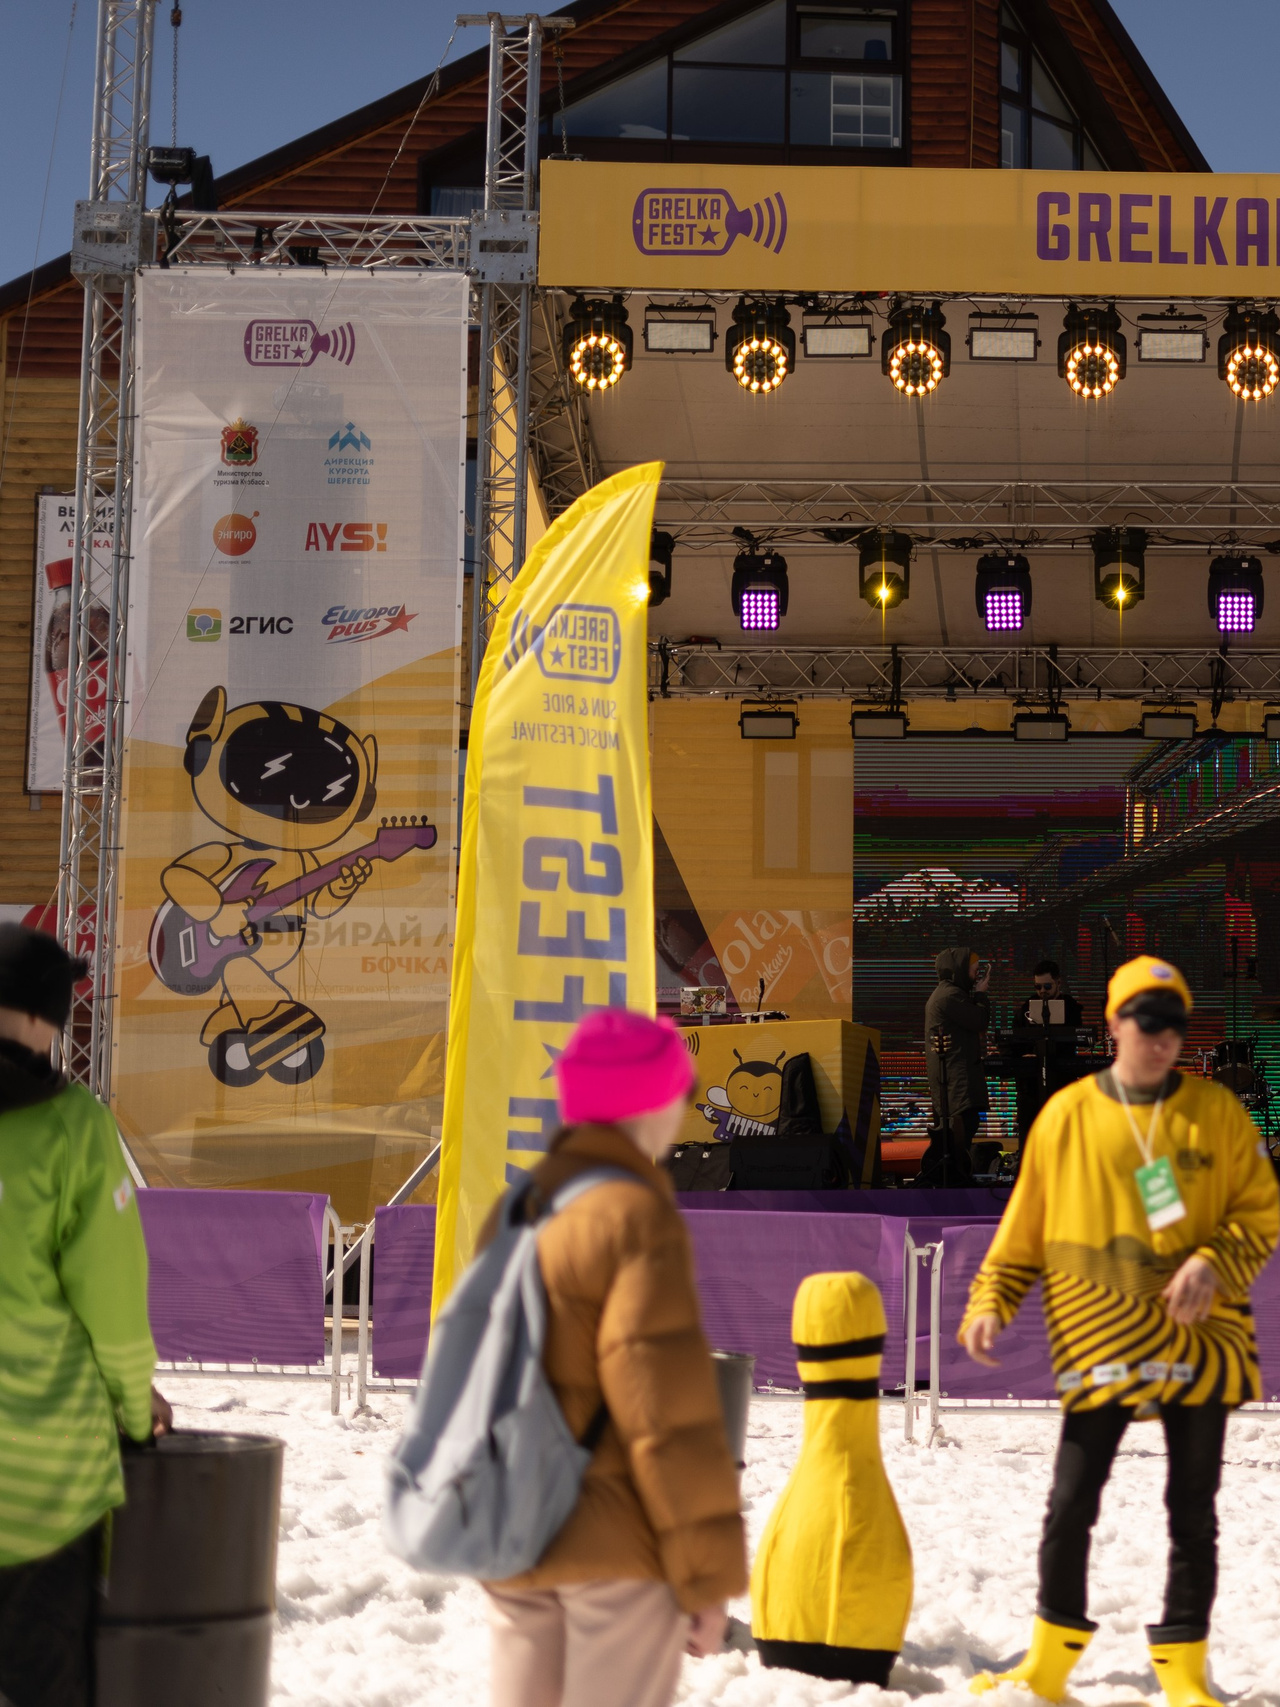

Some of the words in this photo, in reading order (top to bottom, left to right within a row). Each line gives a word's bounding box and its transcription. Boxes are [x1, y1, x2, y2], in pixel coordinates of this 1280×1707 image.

[648, 198, 721, 220] GRELKA
[648, 223, 698, 245] FEST
[255, 326, 308, 342] GRELKA
[255, 344, 291, 360] FEST
[324, 458, 374, 467] ДИРЕКЦИЯ
[217, 470, 263, 478] Министерство
[213, 479, 239, 487] туризма
[218, 530, 253, 542] энгиро
[304, 522, 388, 552] AYS!
[229, 616, 294, 635] 2ГИС
[239, 914, 426, 947] ВЫБИРАЙ
